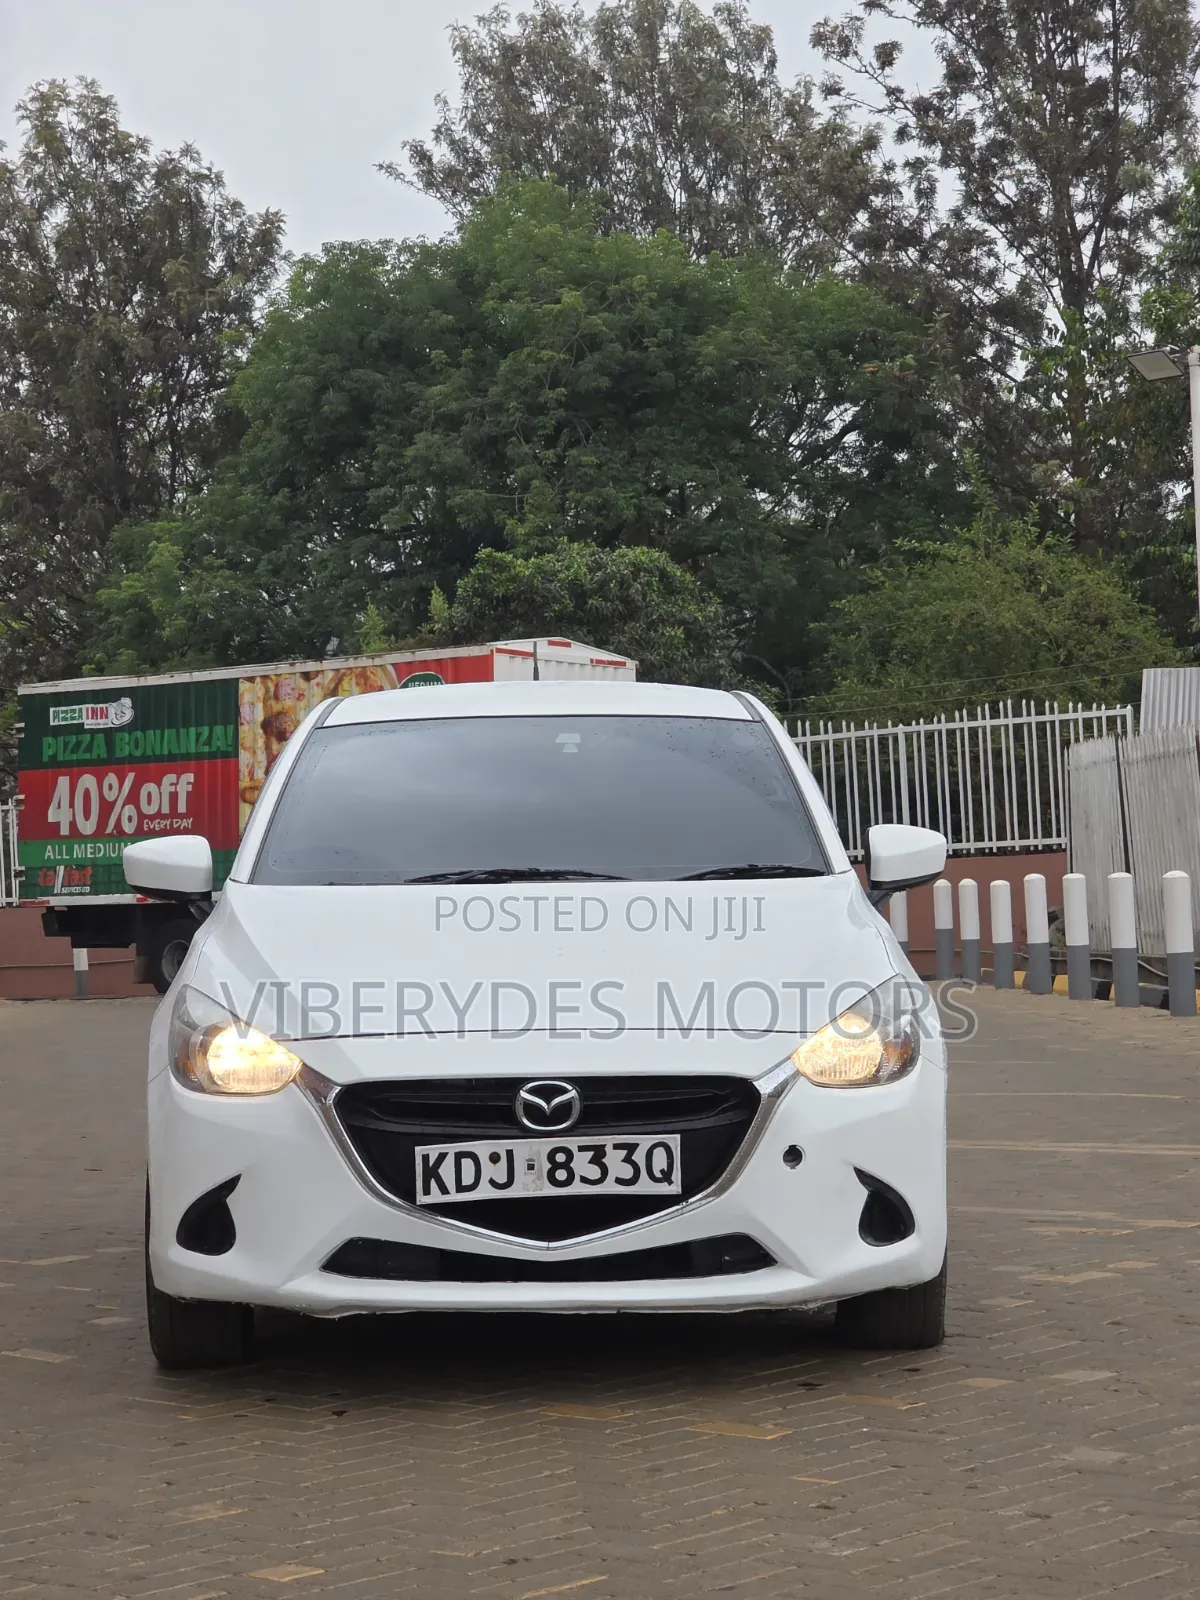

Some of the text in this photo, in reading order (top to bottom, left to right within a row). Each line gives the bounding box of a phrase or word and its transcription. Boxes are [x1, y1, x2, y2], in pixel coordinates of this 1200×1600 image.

[52, 706, 109, 723] PIZZA INN
[42, 725, 234, 762] PIZZA BONANZA!
[48, 772, 194, 836] 40% off
[143, 817, 193, 831] EVERY DAY
[44, 844, 70, 860] ALL
[420, 1140, 676, 1197] KDJ 833Q
